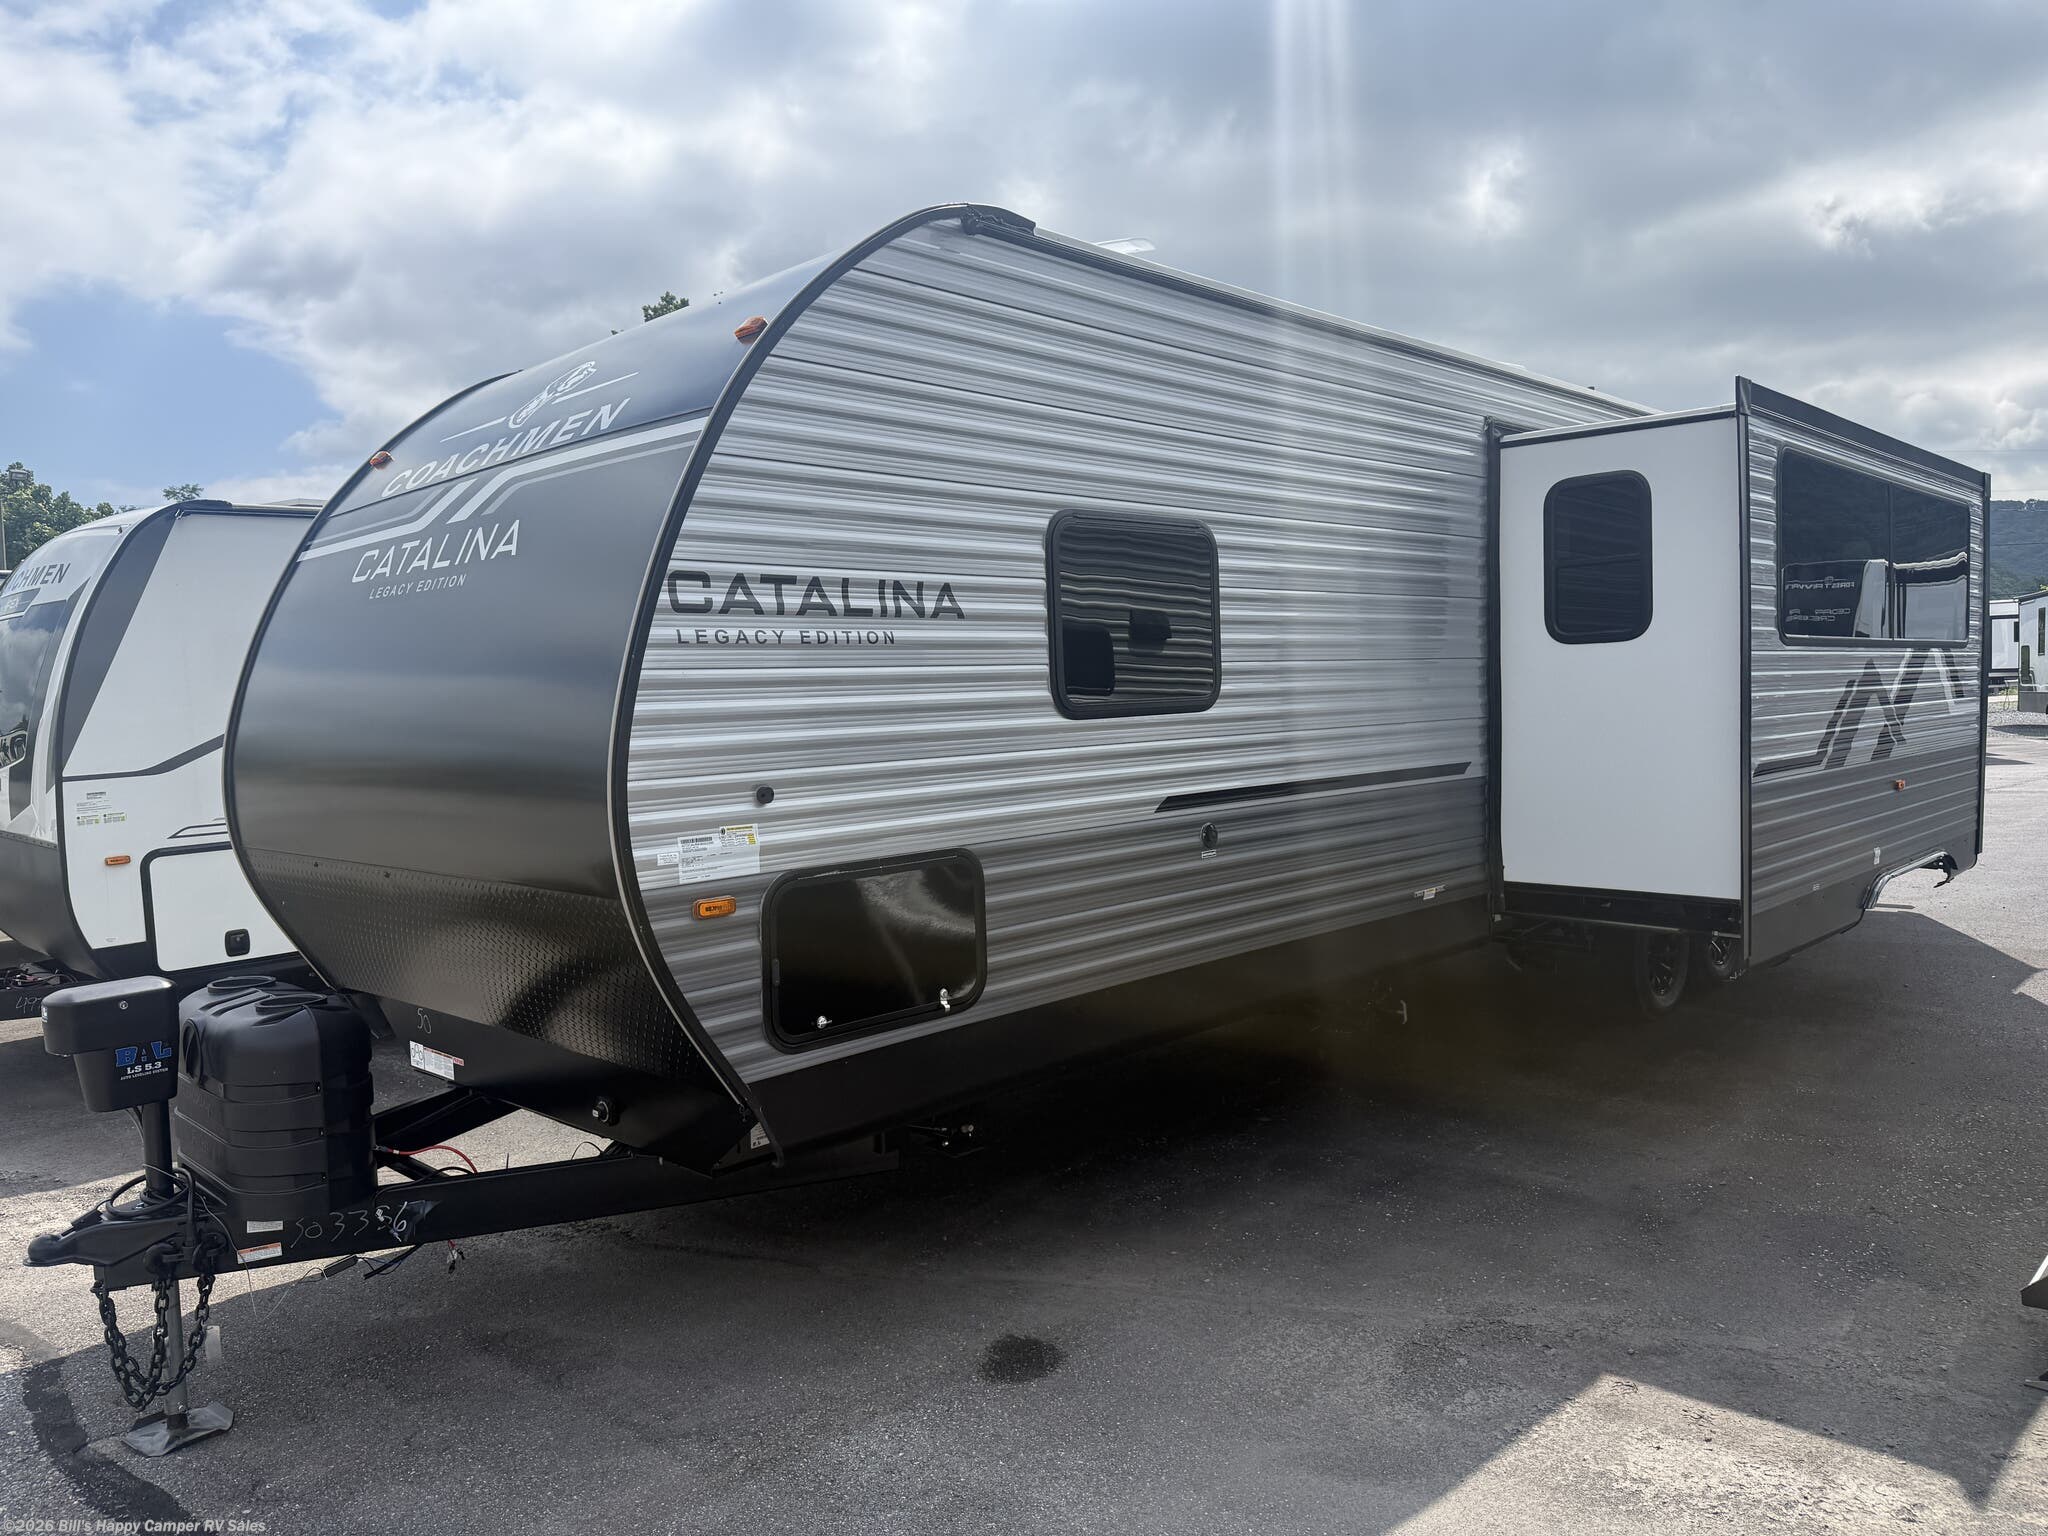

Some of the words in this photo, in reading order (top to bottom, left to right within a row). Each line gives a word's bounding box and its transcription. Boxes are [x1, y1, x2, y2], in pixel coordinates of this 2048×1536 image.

[381, 397, 631, 498] COACHMEN
[352, 519, 520, 583] CATALINA
[368, 580, 413, 600] LEGACY
[416, 573, 467, 593] EDITION
[667, 570, 965, 619] CATALINA
[676, 629, 785, 645] LEGACY
[800, 630, 895, 645] EDITION
[126, 1064, 143, 1075] LS
[145, 1061, 162, 1071] 5.3
